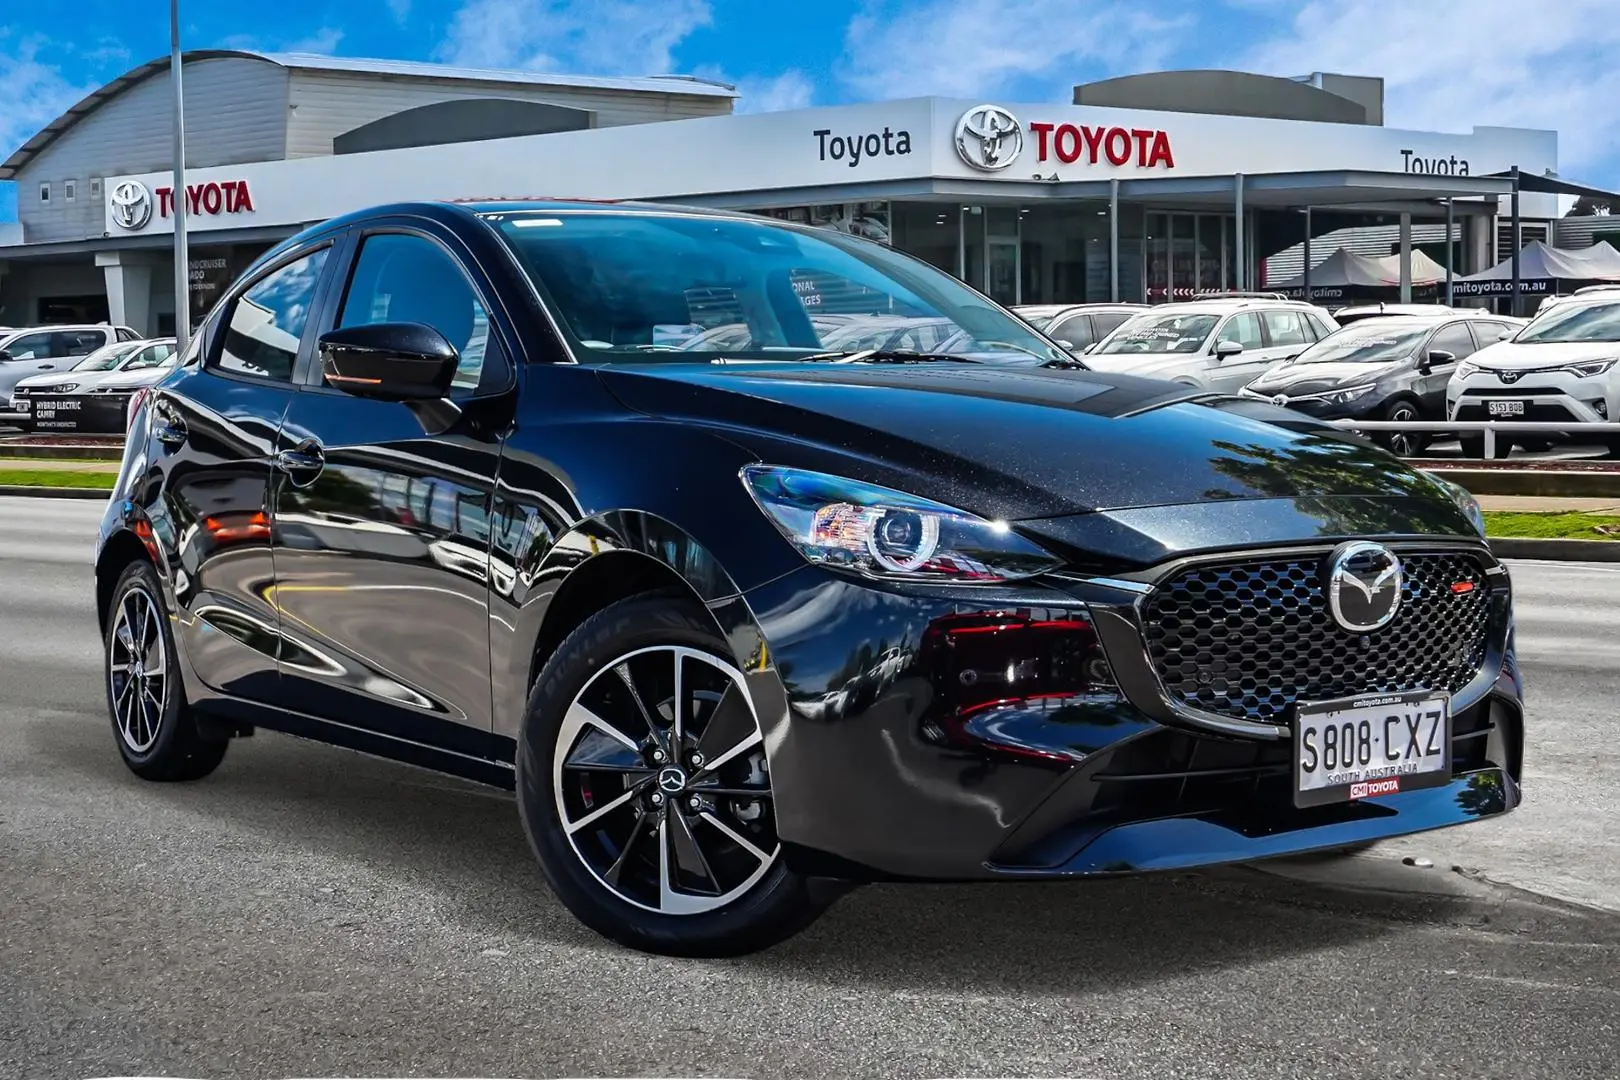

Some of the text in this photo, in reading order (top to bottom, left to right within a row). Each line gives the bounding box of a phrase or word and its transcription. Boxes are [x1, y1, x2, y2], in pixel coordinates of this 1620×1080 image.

[813, 128, 911, 168] Toyota
[1030, 122, 1174, 169] TOYOTA
[1452, 281, 1546, 295] mitoyota.cm.au
[36, 401, 81, 411] HYBRID ELECTRIC
[36, 410, 55, 419] CAMRY
[1353, 697, 1402, 709] cmitoyota.com.au
[1327, 763, 1418, 785] SOUTH AUSTRALIA
[1368, 780, 1399, 795] TOYOTA
